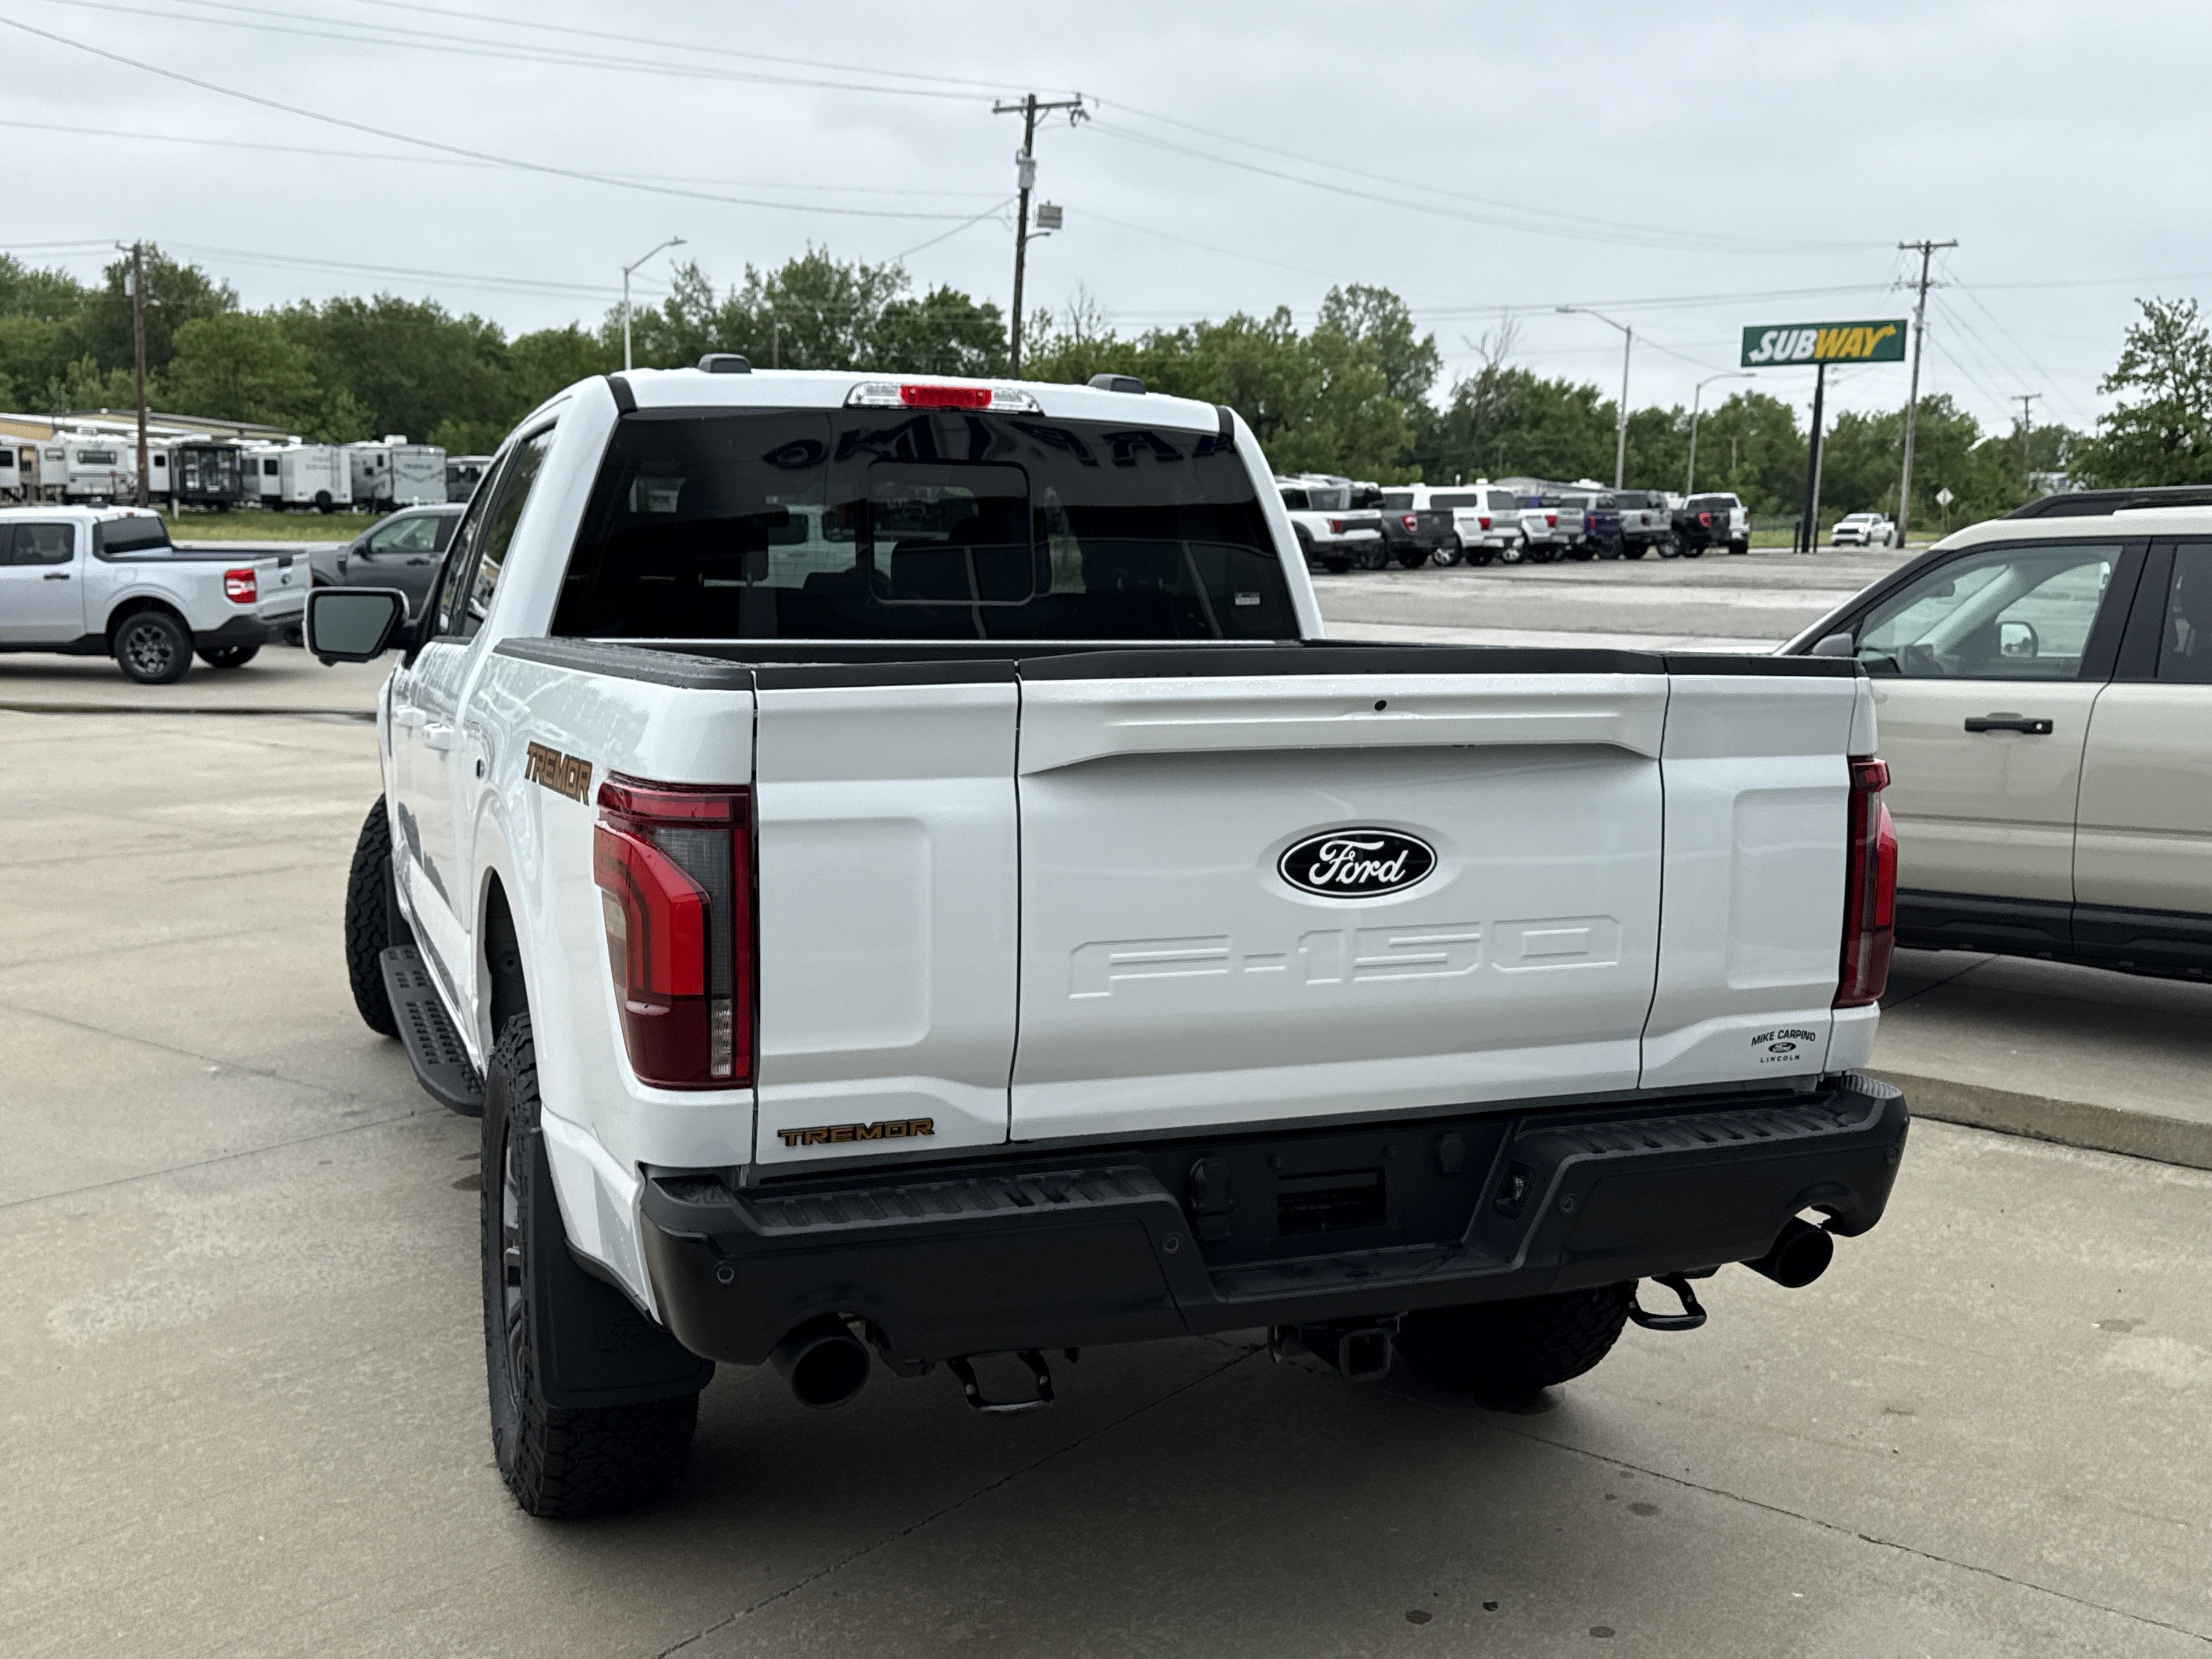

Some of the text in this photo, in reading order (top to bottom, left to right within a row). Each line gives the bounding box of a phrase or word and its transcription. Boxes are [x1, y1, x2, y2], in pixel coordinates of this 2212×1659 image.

[1749, 325, 1897, 362] SUBWAY
[524, 741, 592, 806] TREMOR
[1308, 840, 1408, 884] Ford
[1069, 915, 1621, 1000] F-150
[1751, 1029, 1816, 1046] MIKE CARPINO
[1760, 1054, 1800, 1063] LINCOLN
[777, 1118, 935, 1146] TREMOR
